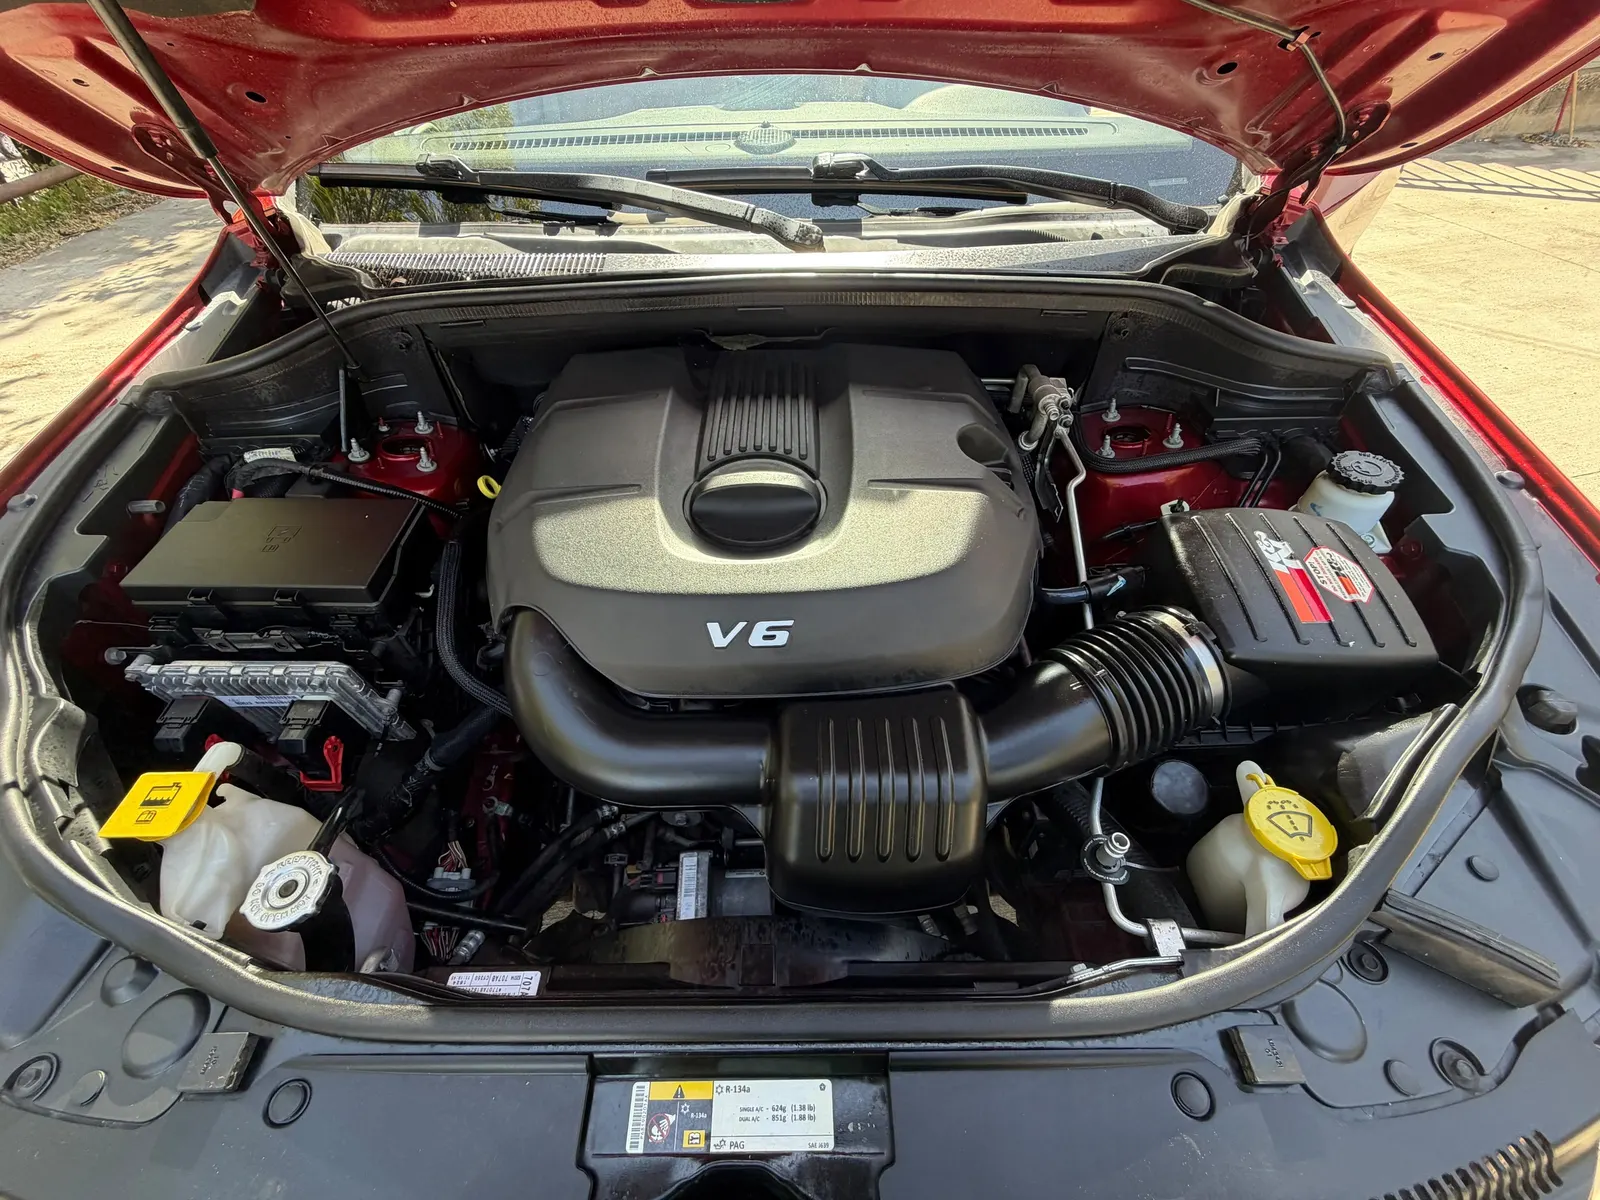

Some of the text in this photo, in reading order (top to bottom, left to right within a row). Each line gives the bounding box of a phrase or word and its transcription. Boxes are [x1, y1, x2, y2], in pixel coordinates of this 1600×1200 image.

[1307, 561, 1327, 585] STOP!
[1324, 576, 1333, 584] NOT
[706, 620, 794, 648] V6
[725, 1084, 750, 1094] R-134a
[772, 1104, 786, 1112] 624g
[790, 1104, 806, 1112] (1.38
[806, 1104, 816, 1112] lb)
[772, 1114, 786, 1122] 851g
[790, 1114, 806, 1122] (1.88
[806, 1114, 816, 1122] lb)
[729, 1140, 745, 1150] PAG
